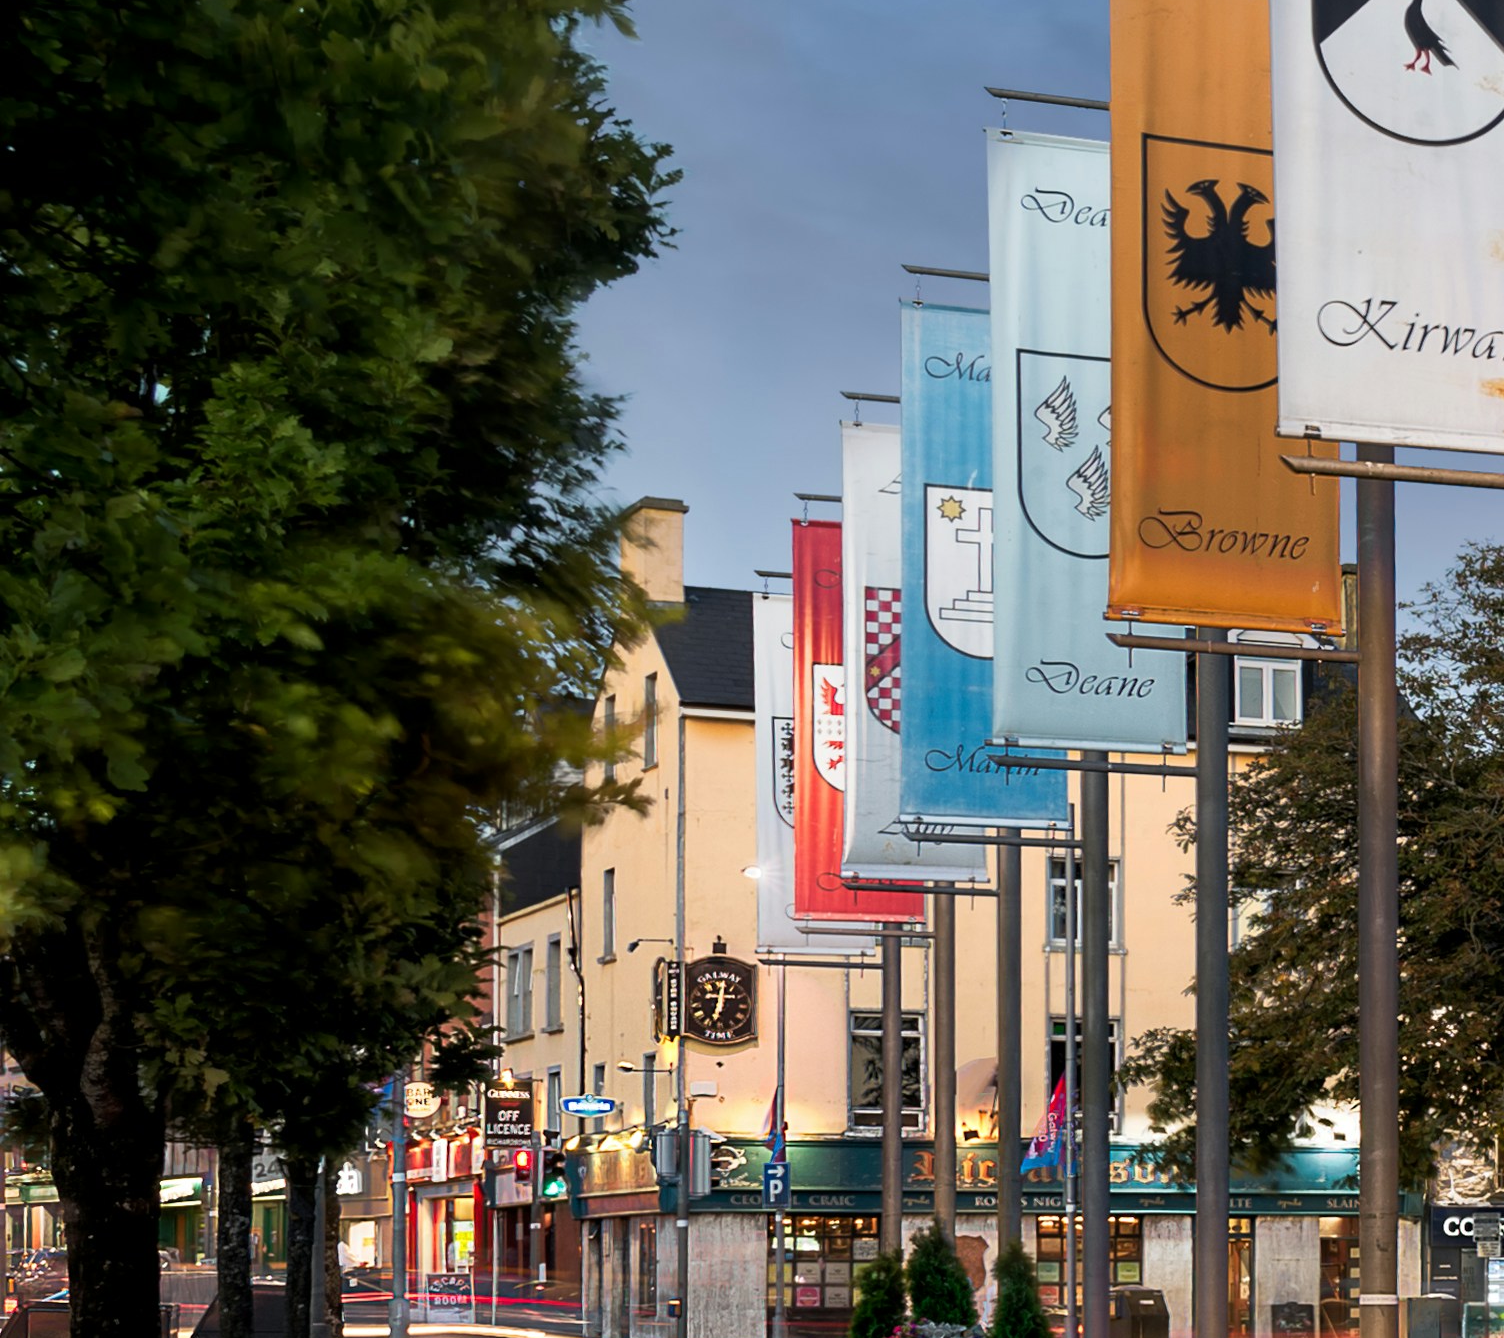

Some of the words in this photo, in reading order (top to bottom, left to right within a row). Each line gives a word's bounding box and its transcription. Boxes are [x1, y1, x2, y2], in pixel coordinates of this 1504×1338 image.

[1020, 187, 1110, 227] Dea
[1138, 508, 1310, 559] Browne
[1025, 659, 1156, 698] Deane
[697, 971, 742, 983] GALWAY
[704, 1030, 735, 1039] TIME
[498, 1110, 520, 1121] OFF
[487, 1123, 532, 1135] LICENCE
[253, 1161, 281, 1178] 24
[769, 1180, 784, 1202] P
[730, 1195, 761, 1206] CEO
[809, 1195, 857, 1206] CRAIC
[429, 1276, 471, 1292] ESCAPE
